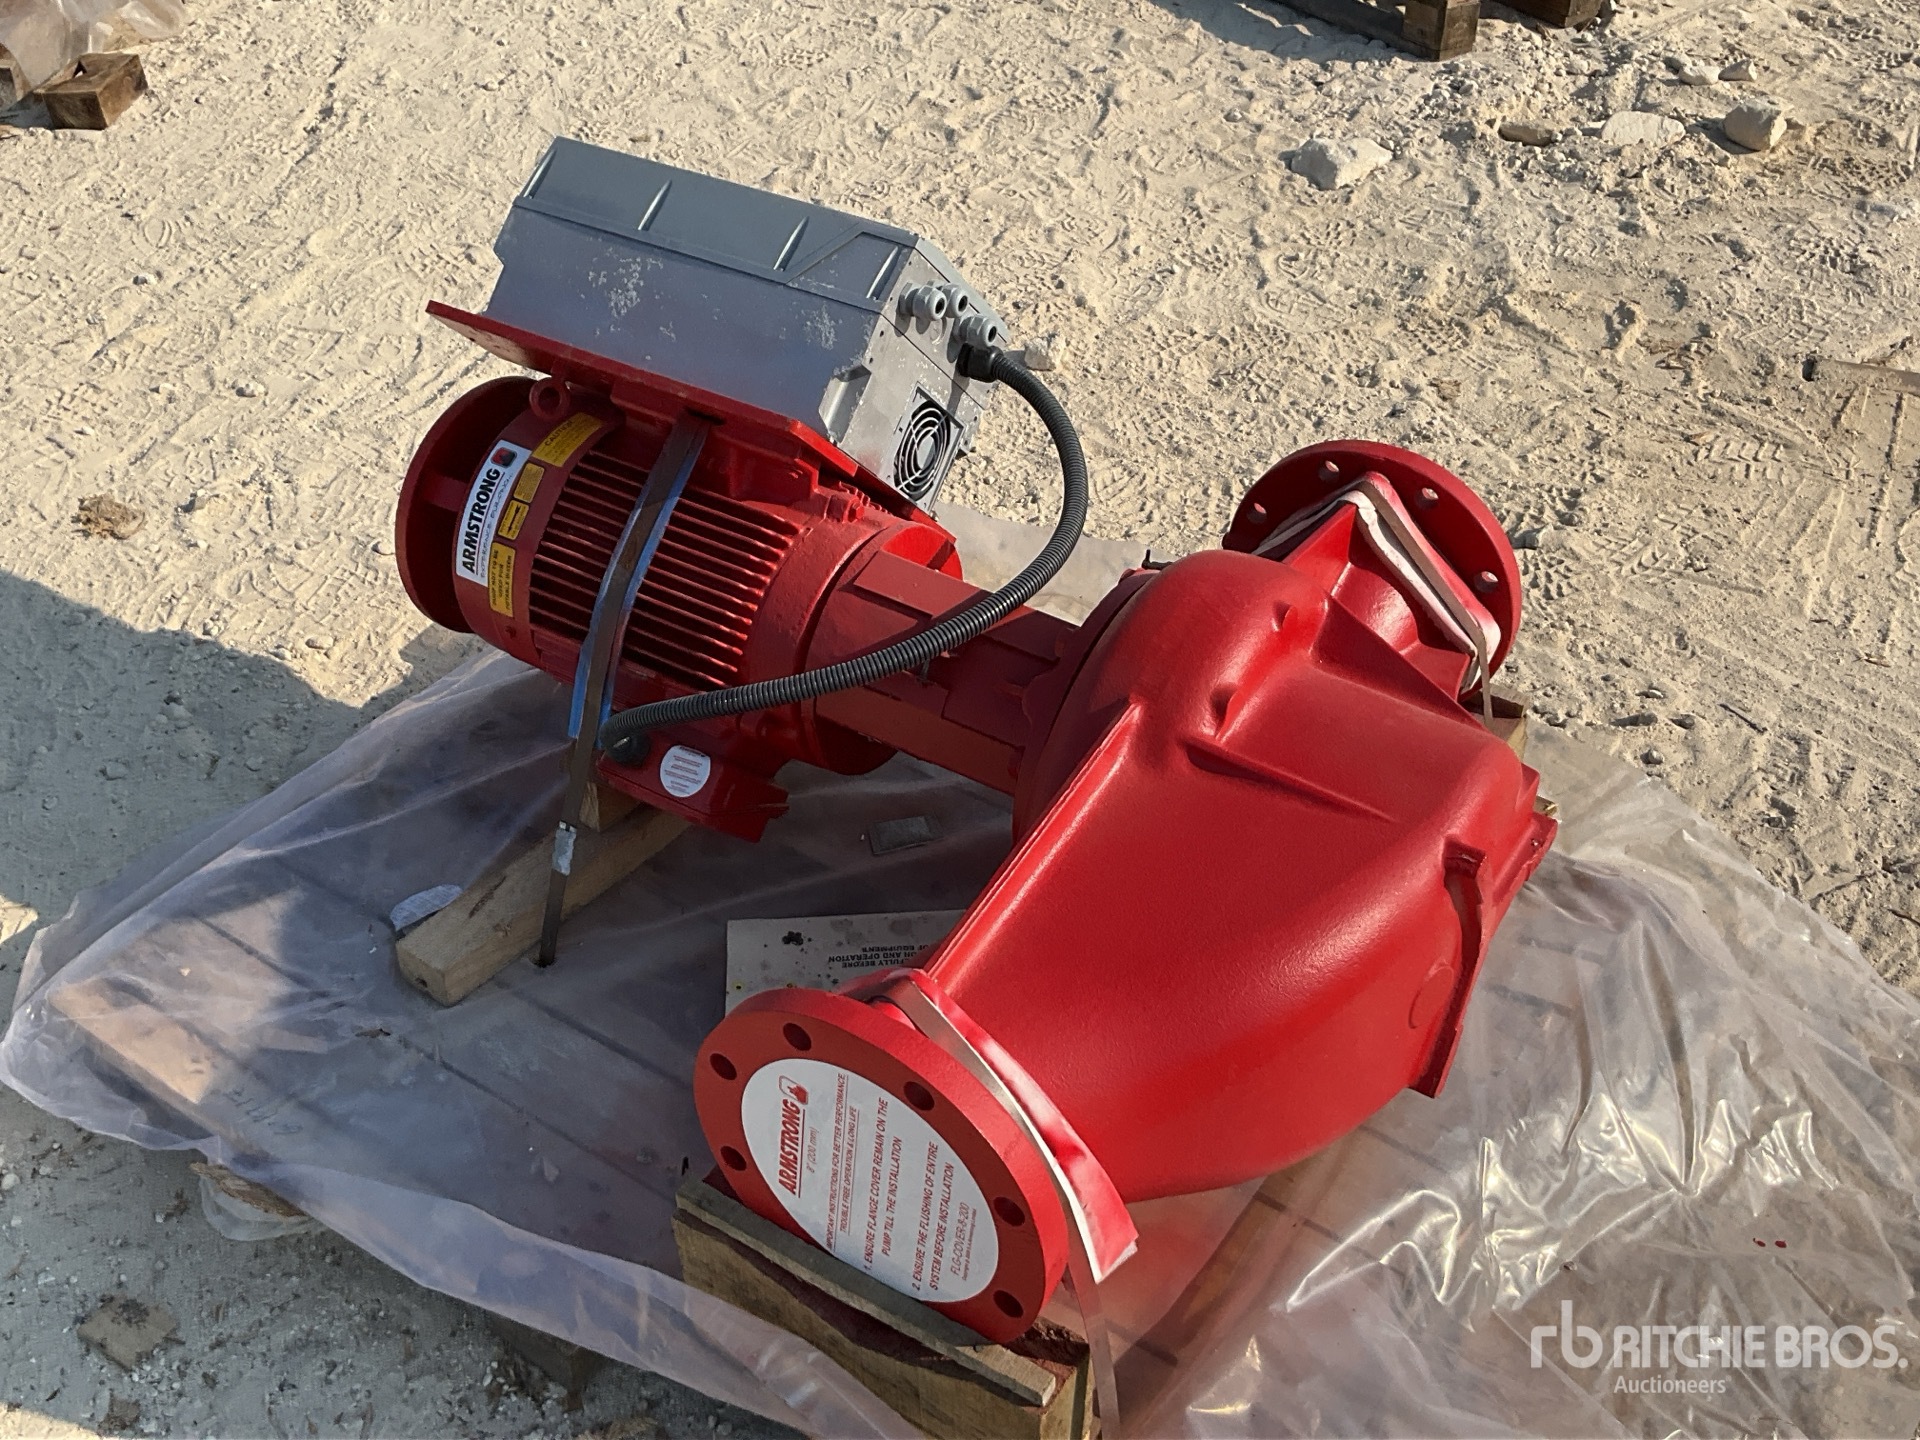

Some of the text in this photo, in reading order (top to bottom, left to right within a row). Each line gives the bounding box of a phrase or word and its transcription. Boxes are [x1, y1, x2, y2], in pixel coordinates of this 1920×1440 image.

[462, 468, 500, 574] ARMSTRONG
[828, 952, 880, 963] OPERATION
[841, 959, 876, 968] BEFORE
[883, 951, 901, 959] AND
[849, 1105, 857, 1123] LIFE
[876, 1117, 886, 1132] ON
[878, 1097, 888, 1117] THE
[778, 1098, 801, 1195] ARMSTRONG
[848, 1122, 856, 1144] LONG
[873, 1131, 885, 1167] REMAIN
[826, 1072, 846, 1250] IMPORTANT INSTRUCTIONS FOR BETTER PERFORMANCE
[844, 1148, 854, 1186] OPERATION
[842, 1186, 851, 1205] FREE
[870, 1166, 881, 1197] COVER
[882, 1136, 902, 1256] PUMP TILL THE INSTALLATION
[840, 1202, 850, 1233] TROUBLE
[867, 1196, 878, 1232] FLANGE
[912, 1141, 939, 1291] 2. ENSURE THE FLUSHING OF ENTIRE
[929, 1161, 954, 1291] SYSTEM BEFORE INSTALLATION
[864, 1229, 875, 1264] ENSURE
[950, 1202, 970, 1276] FLG-COVER-8-200
